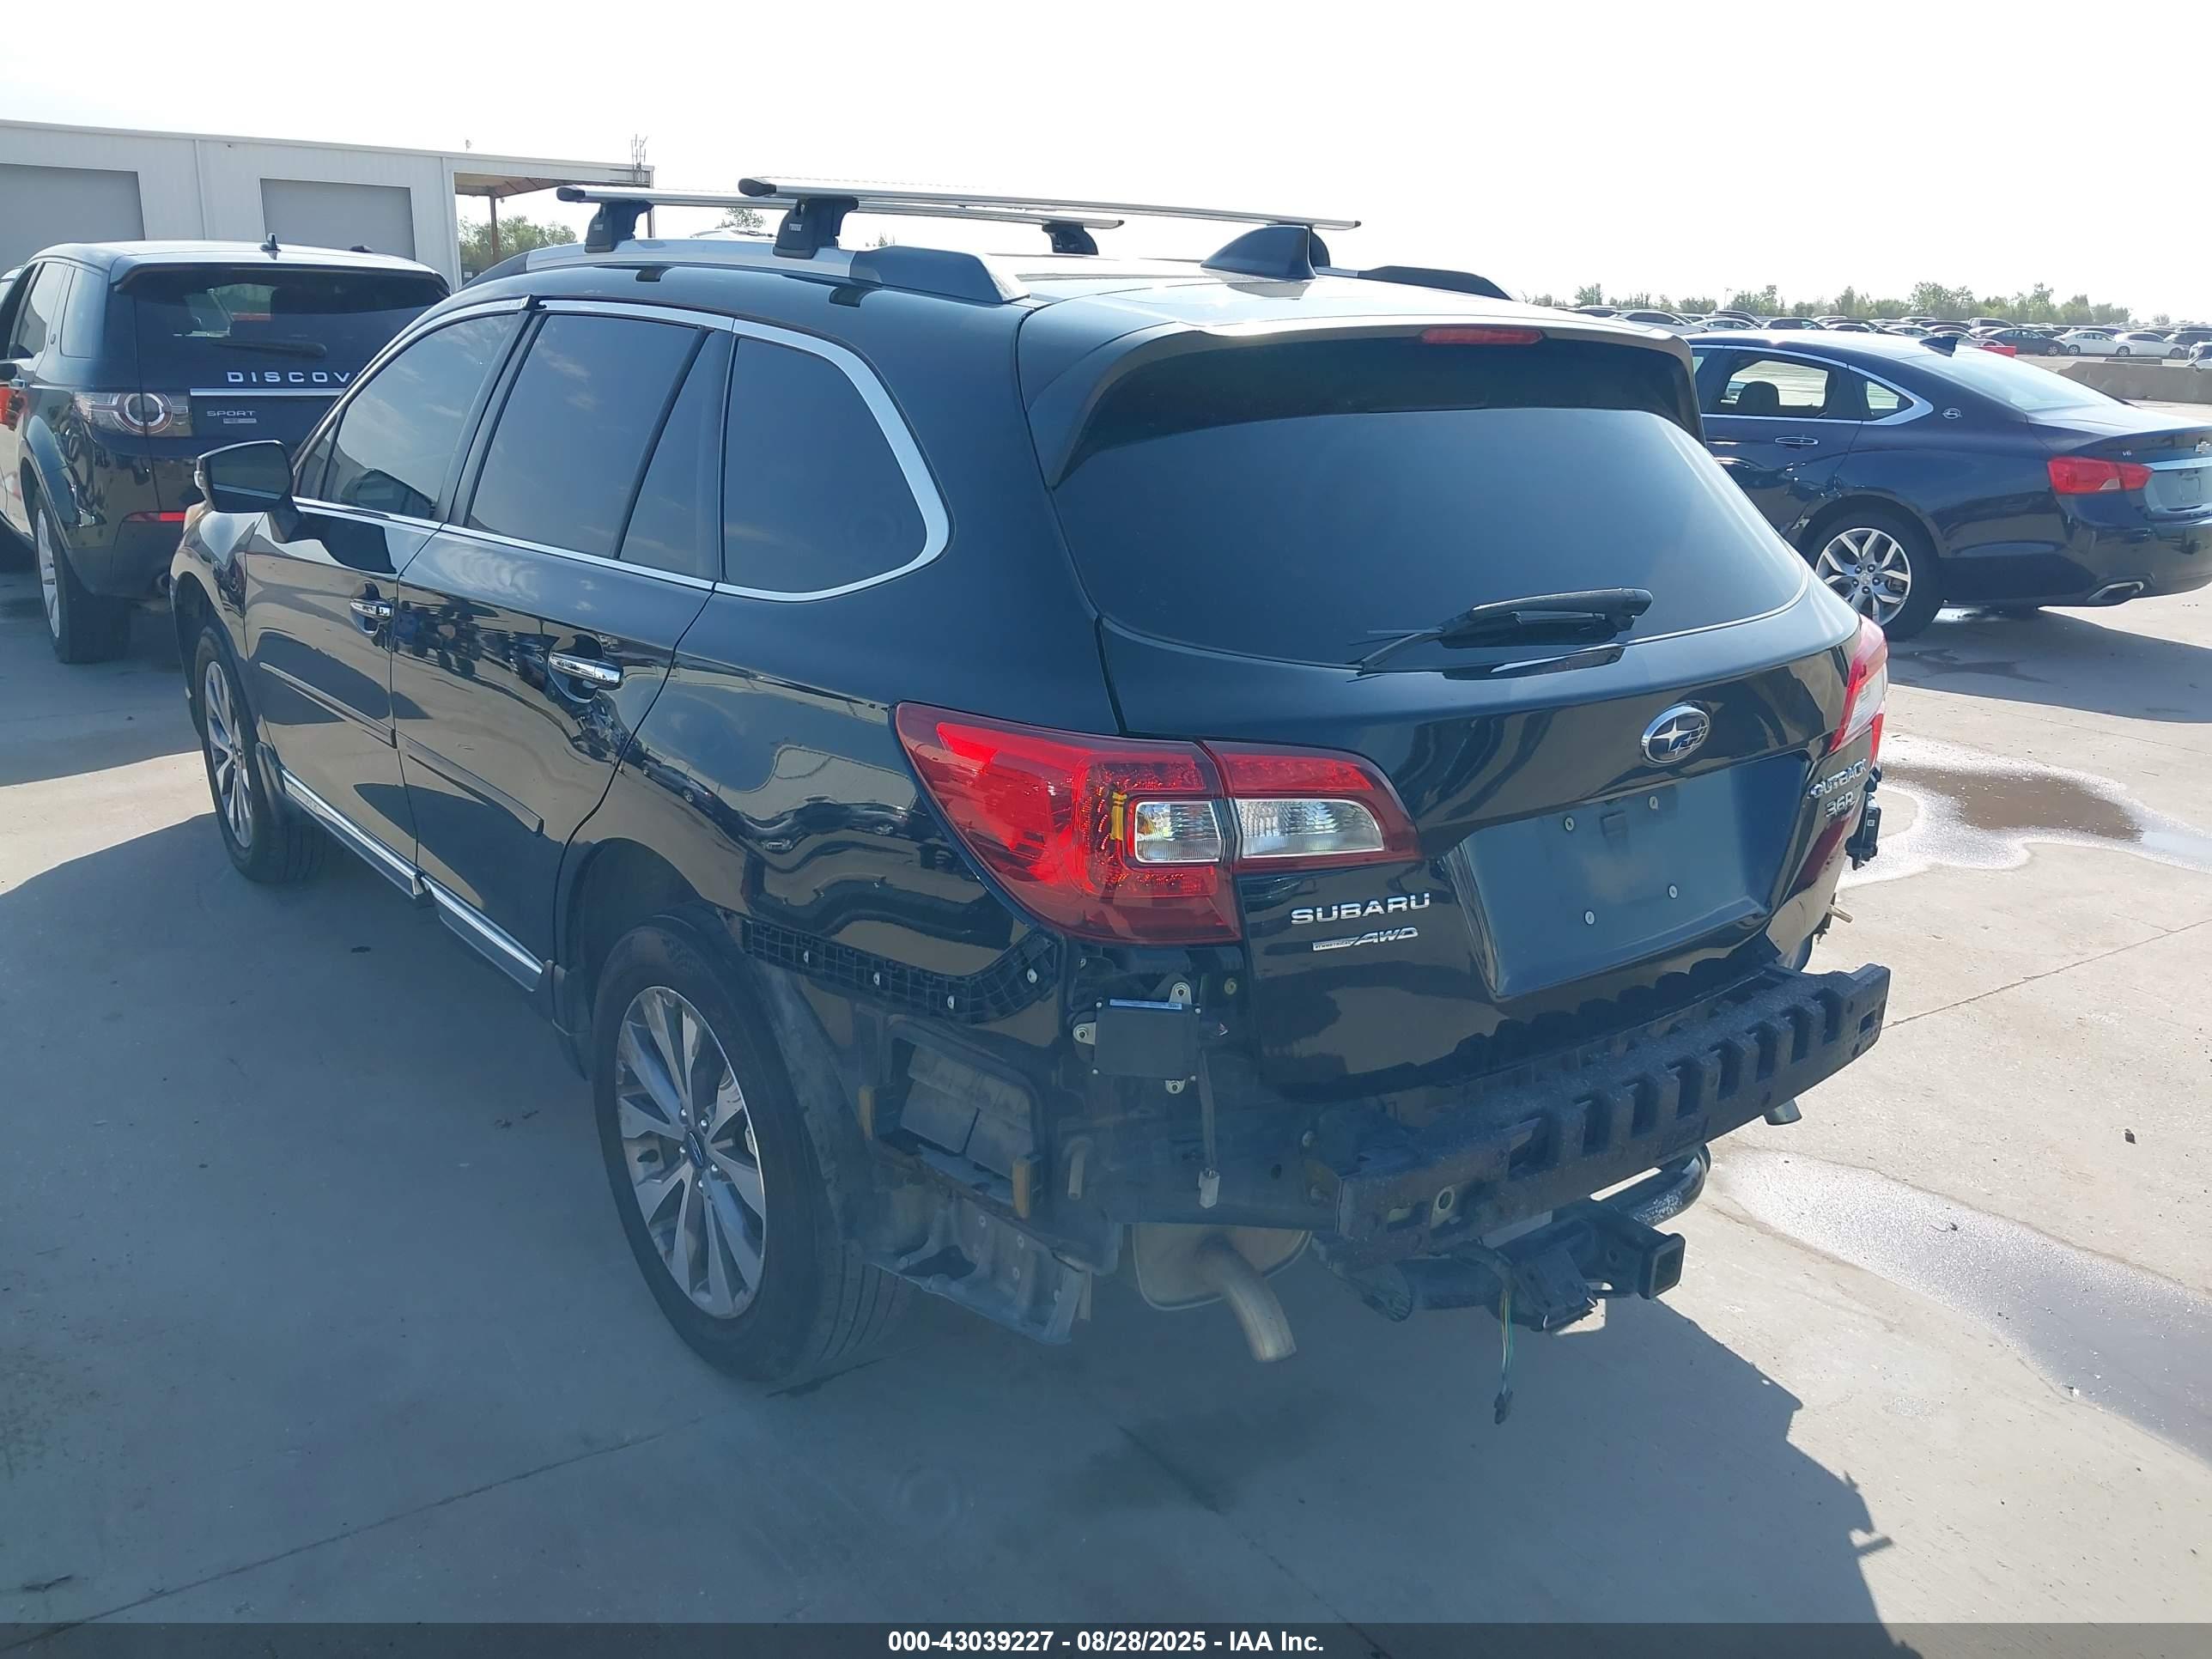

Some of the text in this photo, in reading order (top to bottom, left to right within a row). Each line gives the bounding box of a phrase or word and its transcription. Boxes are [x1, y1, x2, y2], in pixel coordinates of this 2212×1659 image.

[227, 372, 356, 383] DISCOV
[1808, 758, 1866, 799] OUTBACK
[1291, 892, 1431, 925] SUBARU
[1352, 927, 1419, 945] AWD
